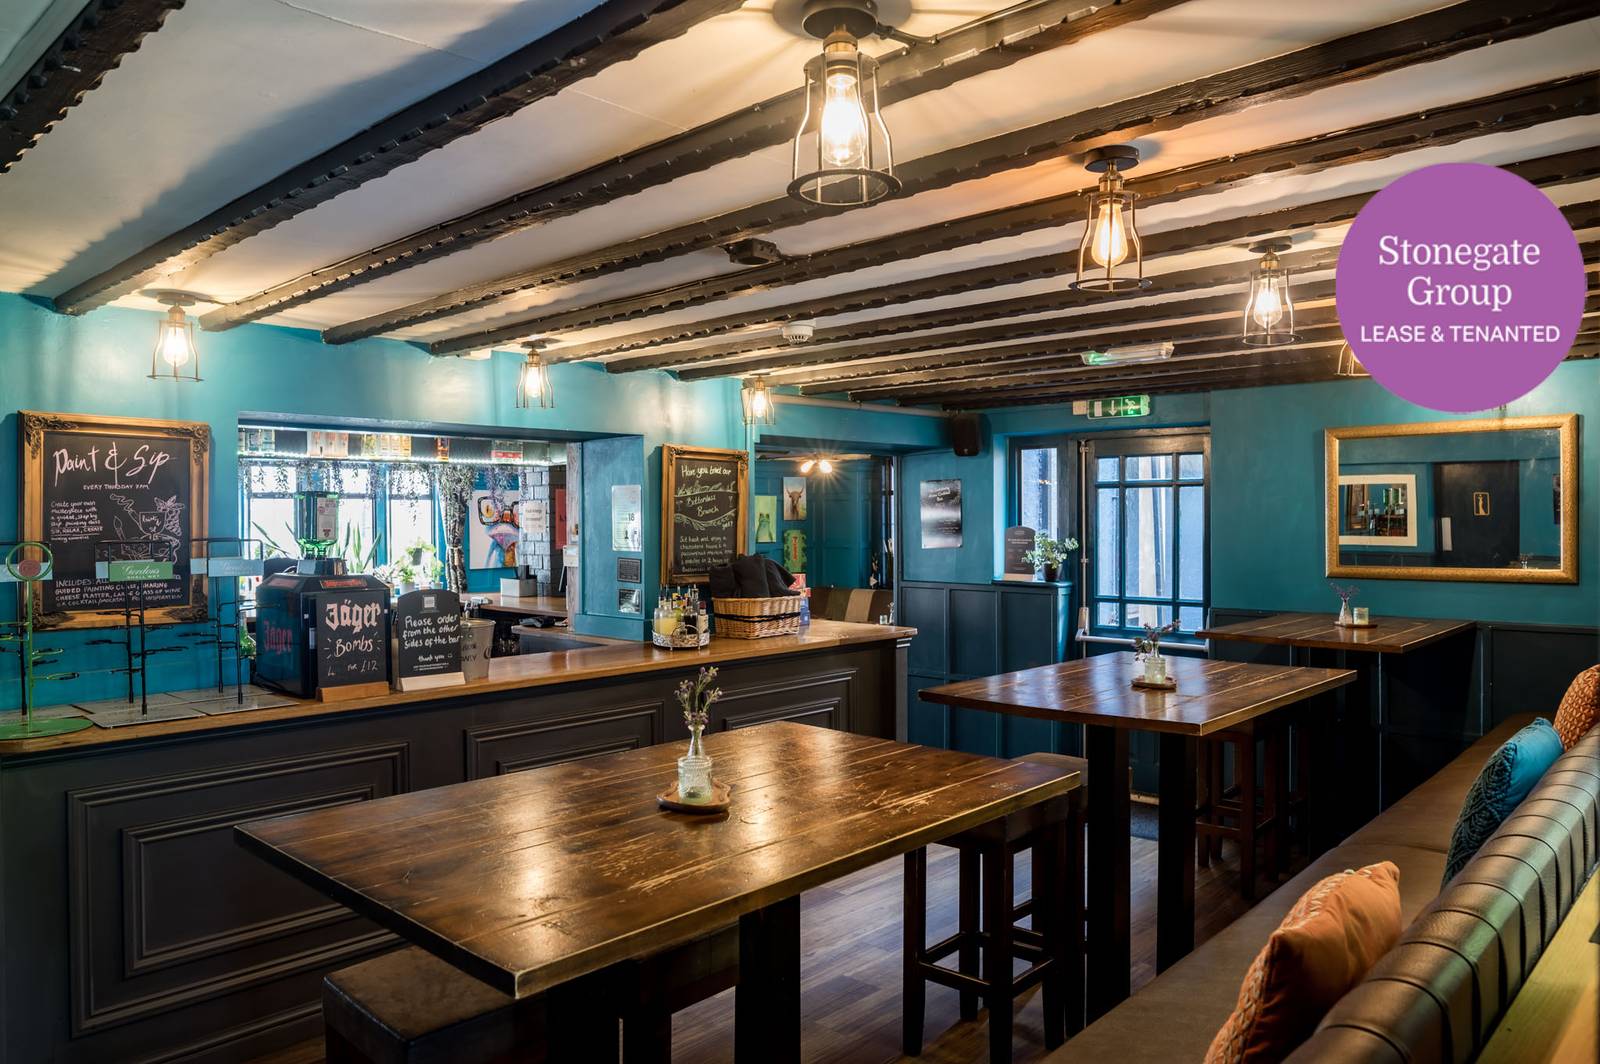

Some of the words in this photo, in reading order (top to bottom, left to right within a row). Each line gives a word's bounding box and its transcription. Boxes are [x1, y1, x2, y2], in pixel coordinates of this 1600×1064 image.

[53, 446, 99, 487] Paint
[105, 441, 127, 485] &
[126, 444, 171, 485] Sip
[696, 467, 708, 479] you
[55, 588, 81, 596] GUIDED
[83, 584, 115, 593] PAINTING
[55, 594, 80, 602] CHEESE
[325, 599, 381, 634] Jäger
[405, 615, 433, 629] Please
[436, 613, 458, 625] order
[402, 630, 421, 640] from
[423, 626, 436, 635] the
[438, 624, 459, 633] other
[334, 634, 373, 658] Bombs
[404, 638, 423, 650] sides
[424, 637, 433, 648] of
[434, 635, 447, 645] the
